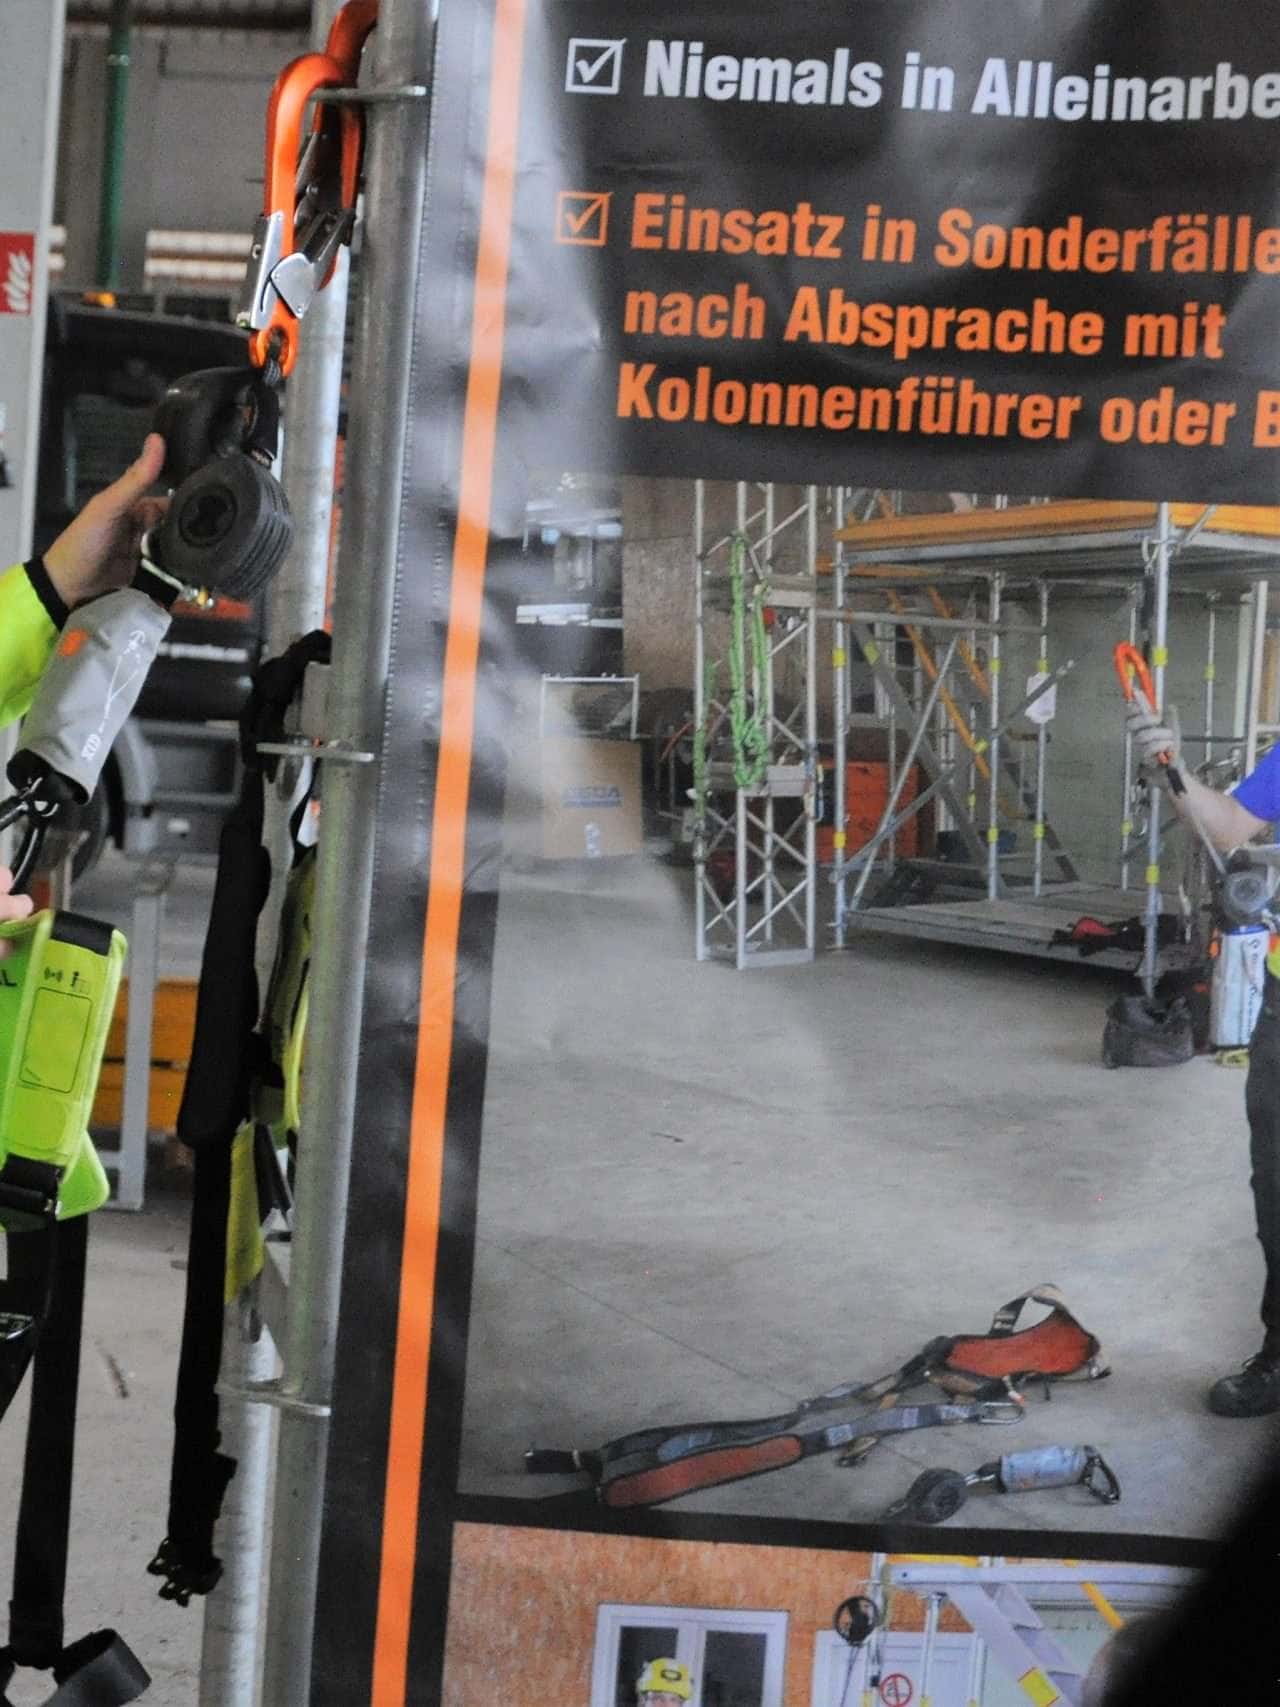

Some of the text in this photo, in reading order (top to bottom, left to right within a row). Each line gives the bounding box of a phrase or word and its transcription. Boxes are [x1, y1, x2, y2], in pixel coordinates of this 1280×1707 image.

[643, 39, 1280, 122] Niemals in Alleinarbe
[631, 192, 1280, 273] Einsatz in Sonderfälle
[623, 283, 1227, 361] nach Absprache mit
[617, 362, 1082, 439] Kolonnenführer
[1100, 386, 1238, 447] oder
